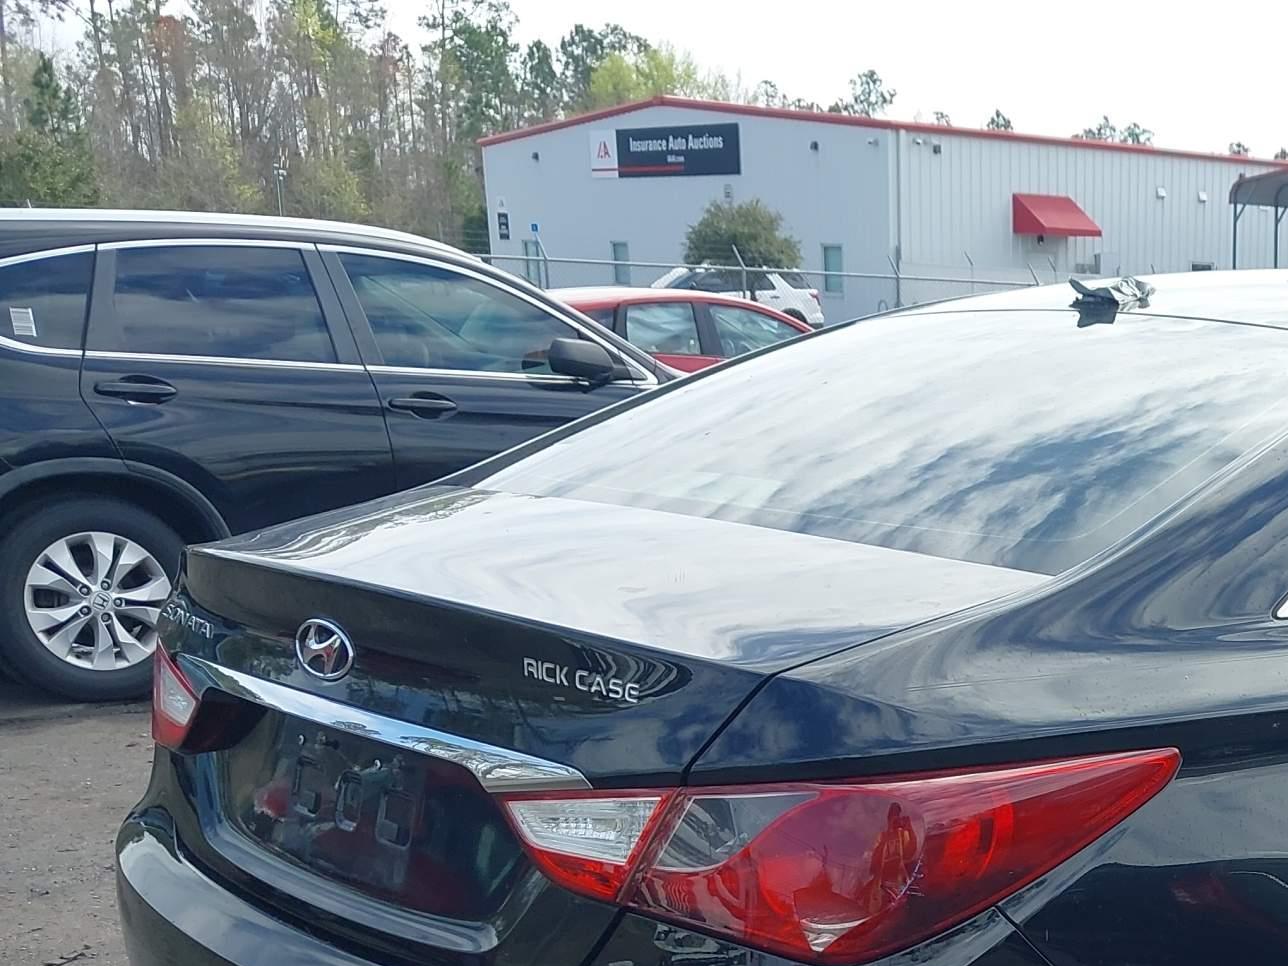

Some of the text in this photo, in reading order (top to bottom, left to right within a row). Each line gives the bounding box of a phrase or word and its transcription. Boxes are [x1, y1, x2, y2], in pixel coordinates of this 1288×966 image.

[629, 133, 724, 152] Insurance Auto Auctions
[523, 657, 640, 704] RICK CASE
